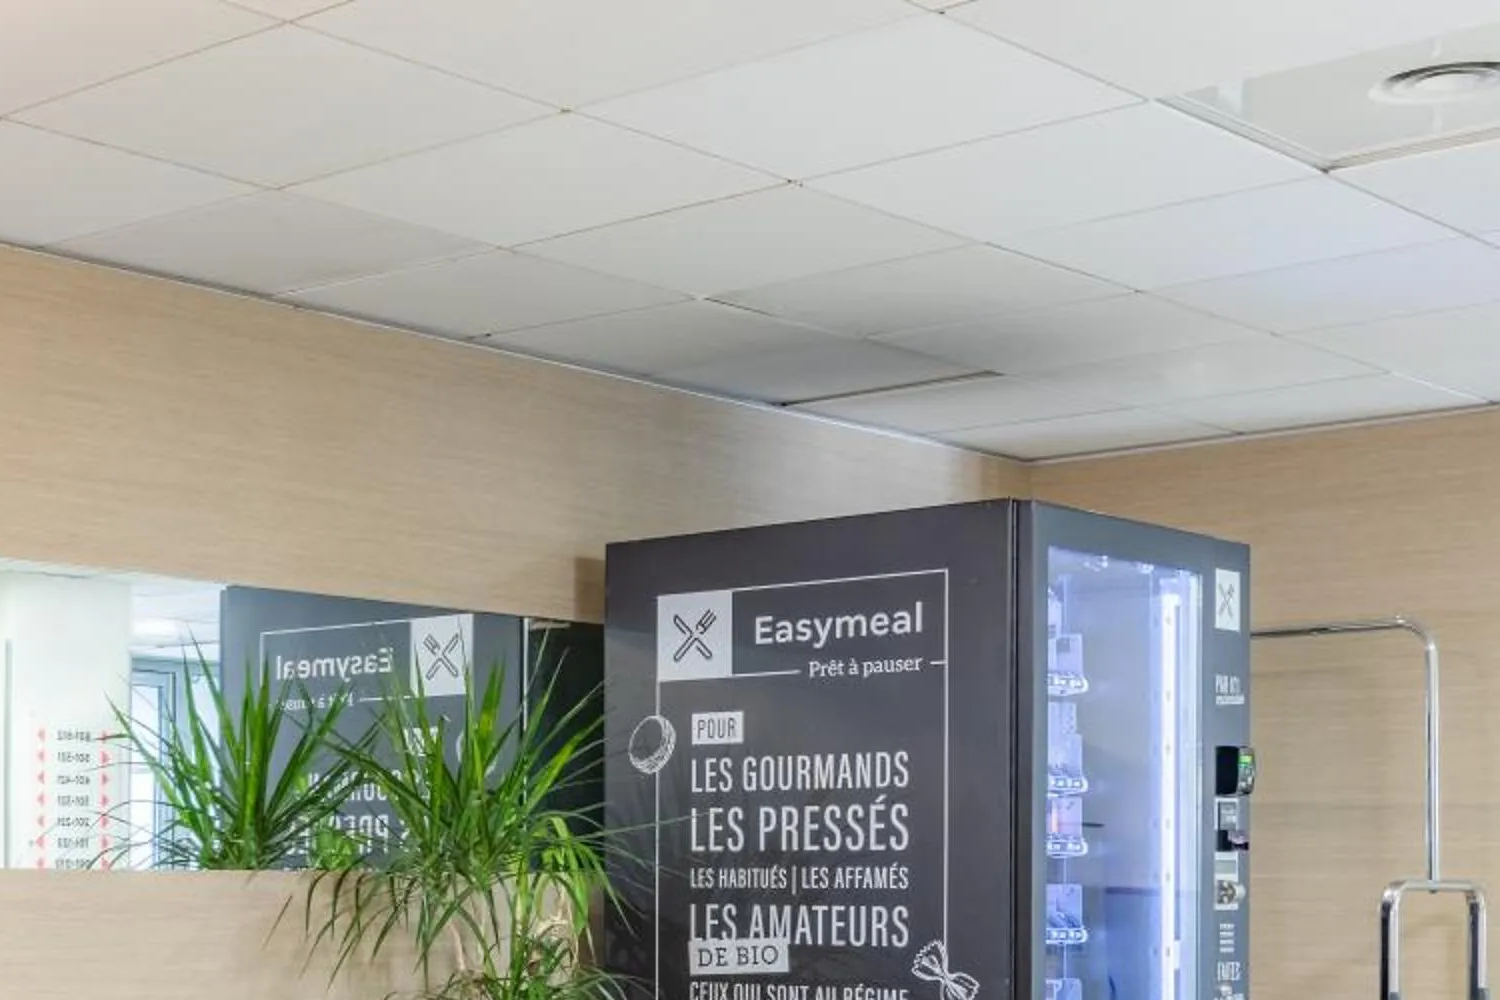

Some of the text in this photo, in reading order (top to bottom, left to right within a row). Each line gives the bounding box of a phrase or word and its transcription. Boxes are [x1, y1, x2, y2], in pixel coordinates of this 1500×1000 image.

[754, 601, 924, 649] Easymeal
[808, 656, 923, 680] Prêt à pauser
[696, 716, 738, 741] POUR
[690, 750, 910, 794] LES GOURMANDS
[690, 795, 910, 853] LES PRESSÉS
[689, 864, 910, 891] LES HABITUÉS LES AFFAMÉS
[689, 903, 910, 949] LES AMATEURS
[698, 945, 779, 968] DE BIO
